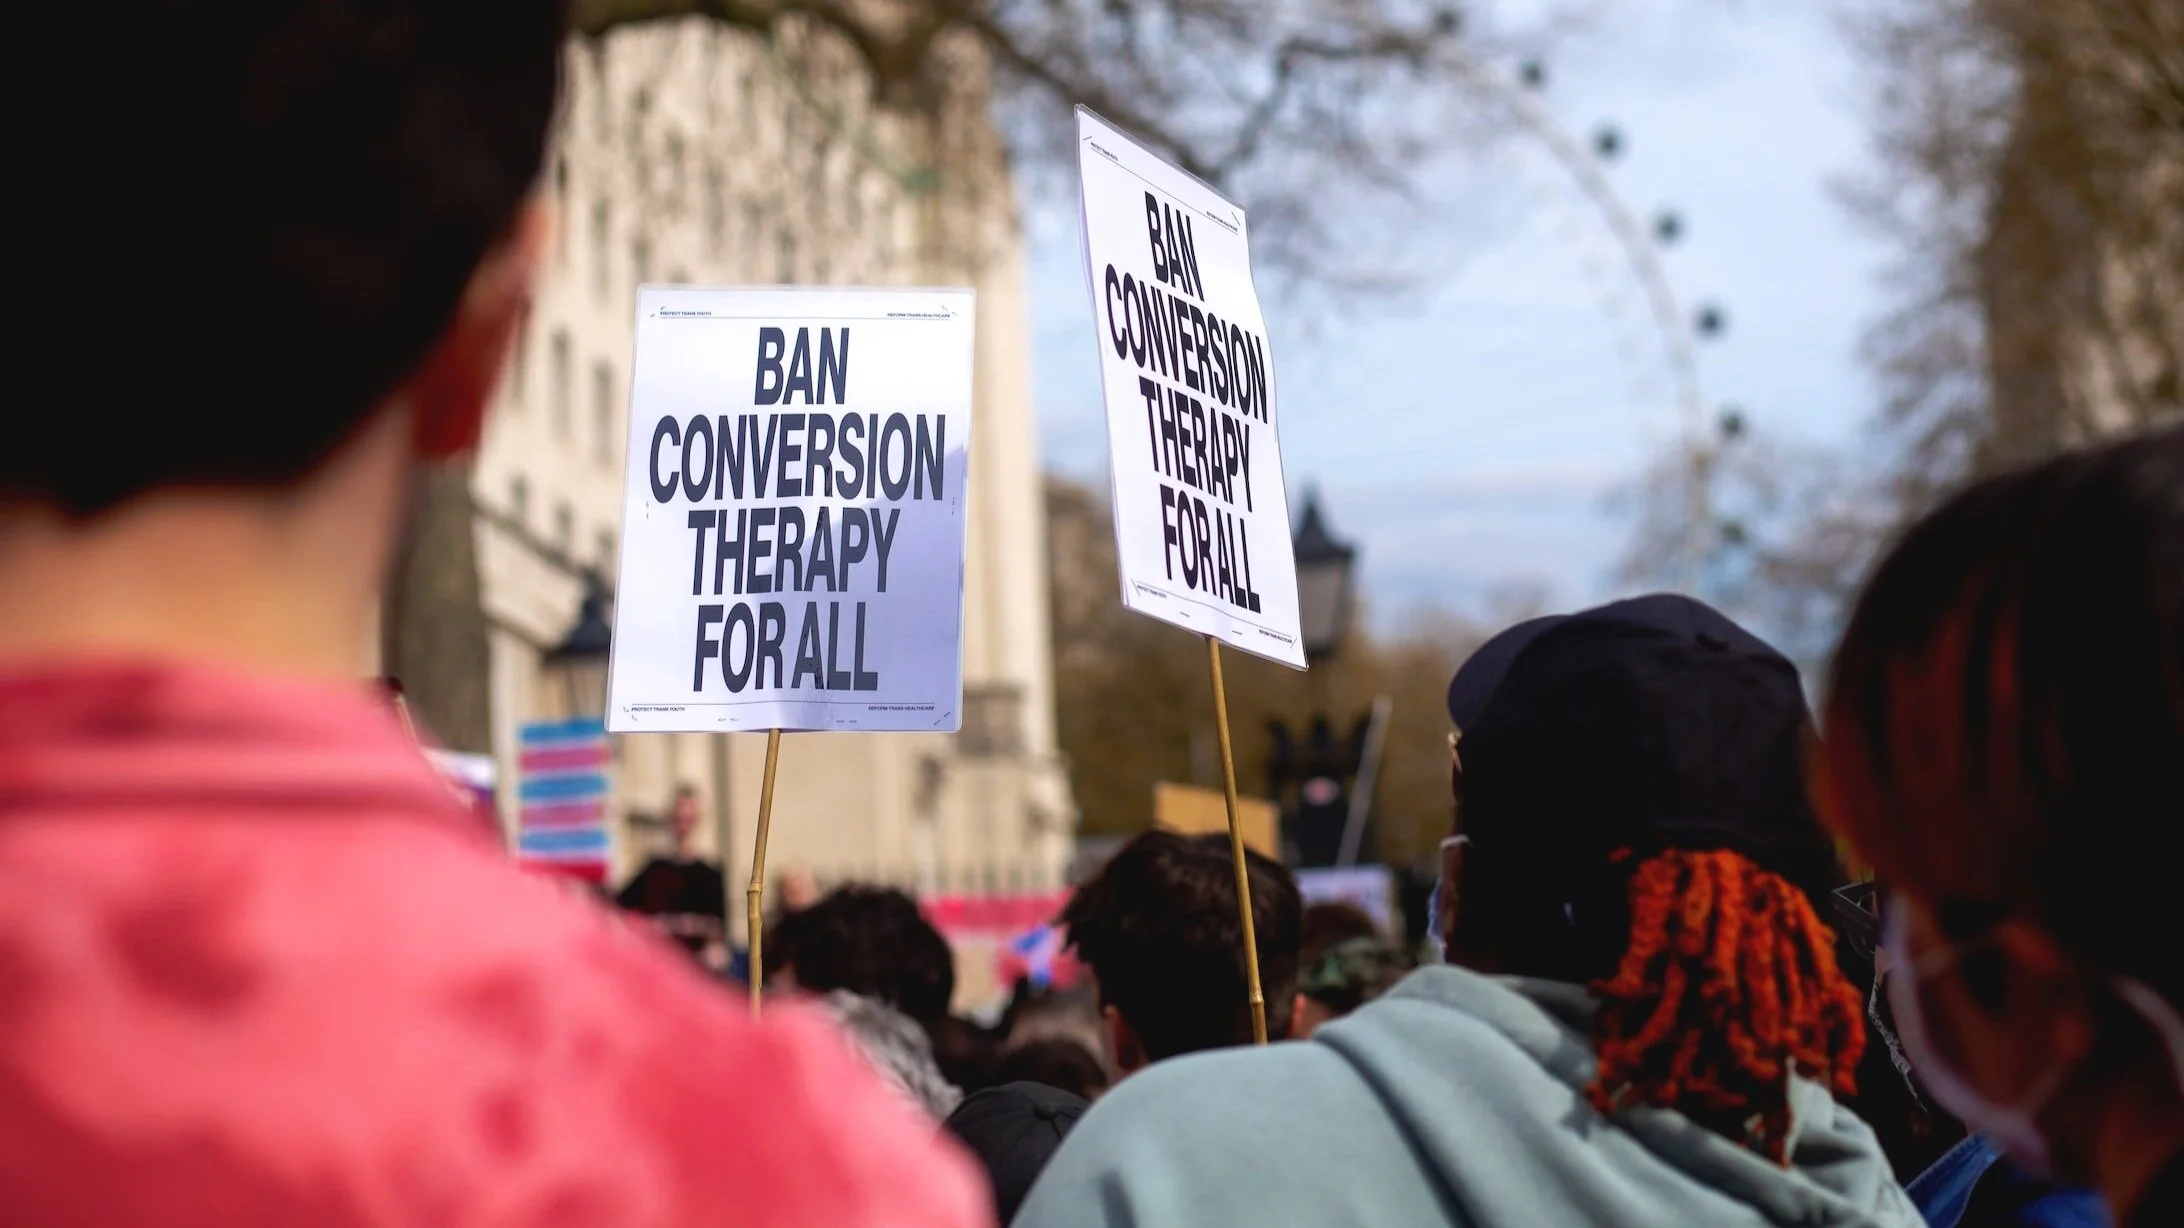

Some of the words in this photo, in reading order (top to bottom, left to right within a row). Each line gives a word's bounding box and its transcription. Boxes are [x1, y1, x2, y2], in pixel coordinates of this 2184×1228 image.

[1144, 190, 1205, 302] BAN
[754, 327, 850, 406] BAN
[1105, 263, 1268, 425] CONVERSION
[649, 412, 946, 504] CONVERSION
[1138, 375, 1253, 513] THERAPY
[687, 506, 901, 596] THERAPY
[1159, 483, 1217, 596] FOR
[1215, 507, 1262, 614] ALL
[693, 601, 787, 694] FOR
[790, 601, 879, 692] ALL
